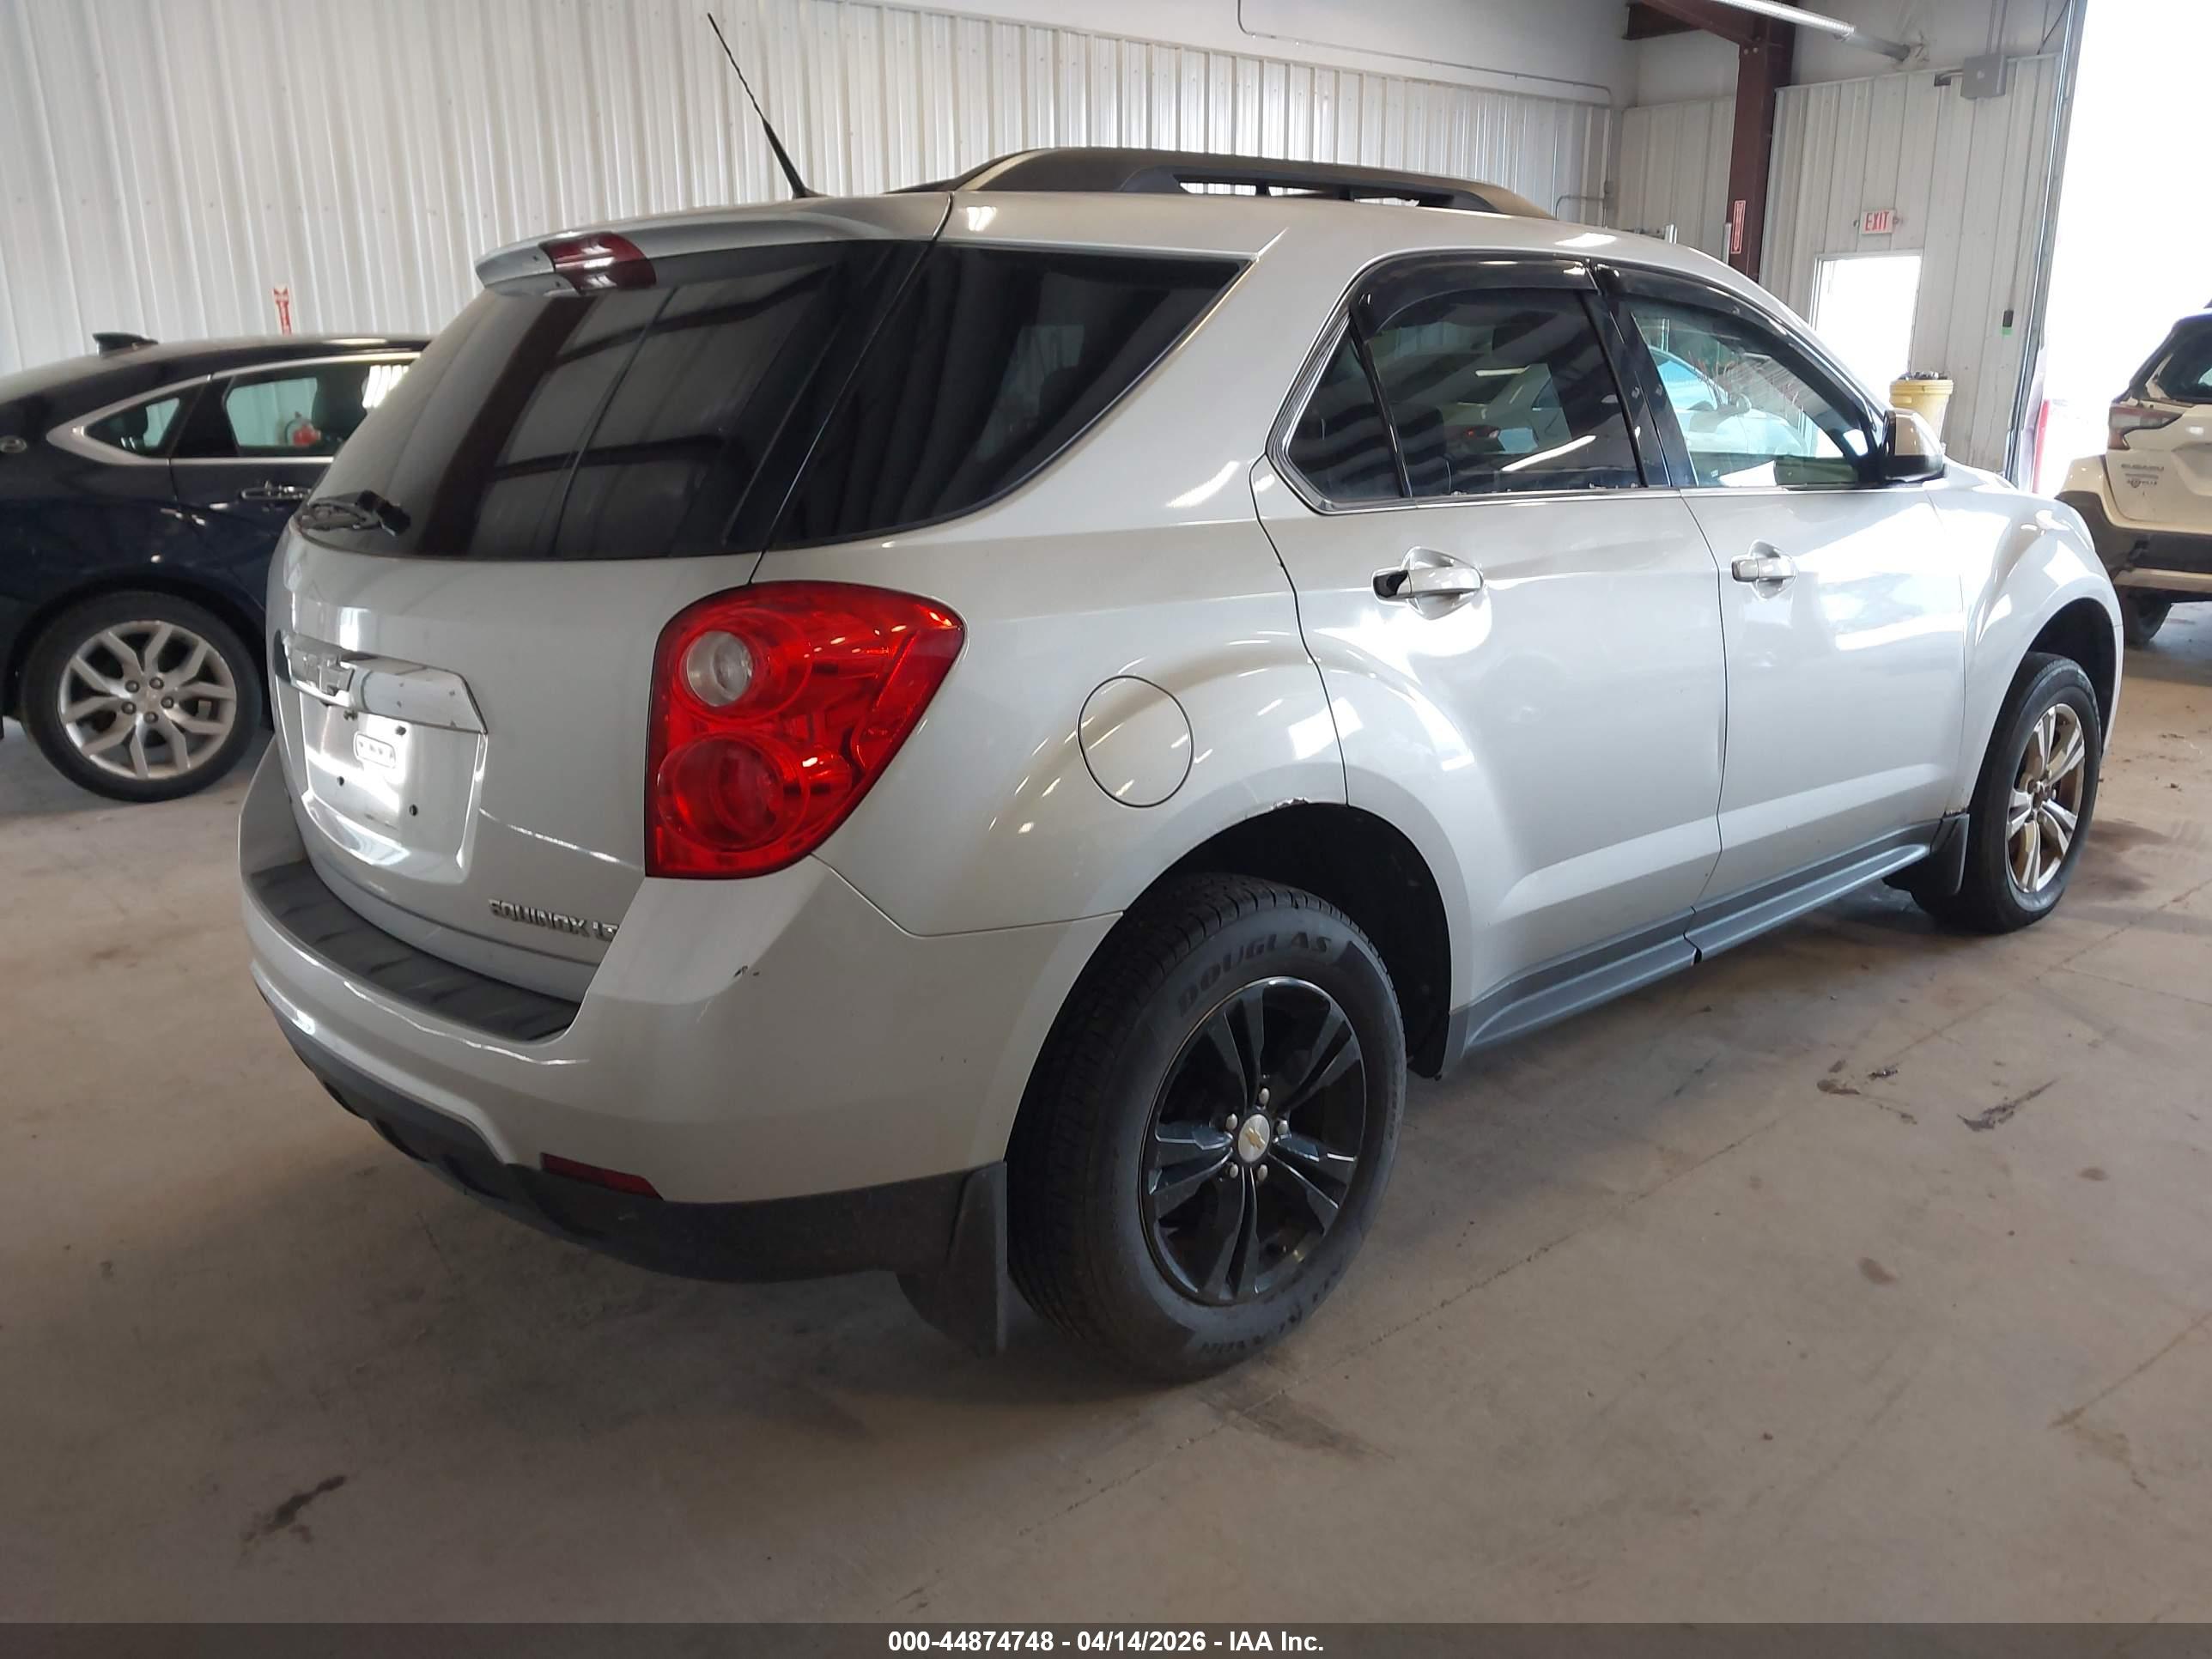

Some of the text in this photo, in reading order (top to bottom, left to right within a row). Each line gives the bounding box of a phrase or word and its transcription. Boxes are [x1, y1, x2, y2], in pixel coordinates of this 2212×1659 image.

[1864, 211, 1890, 231] EXIT
[488, 898, 591, 939] EQUINOX
[1178, 931, 1332, 1018] DOUGLAS
